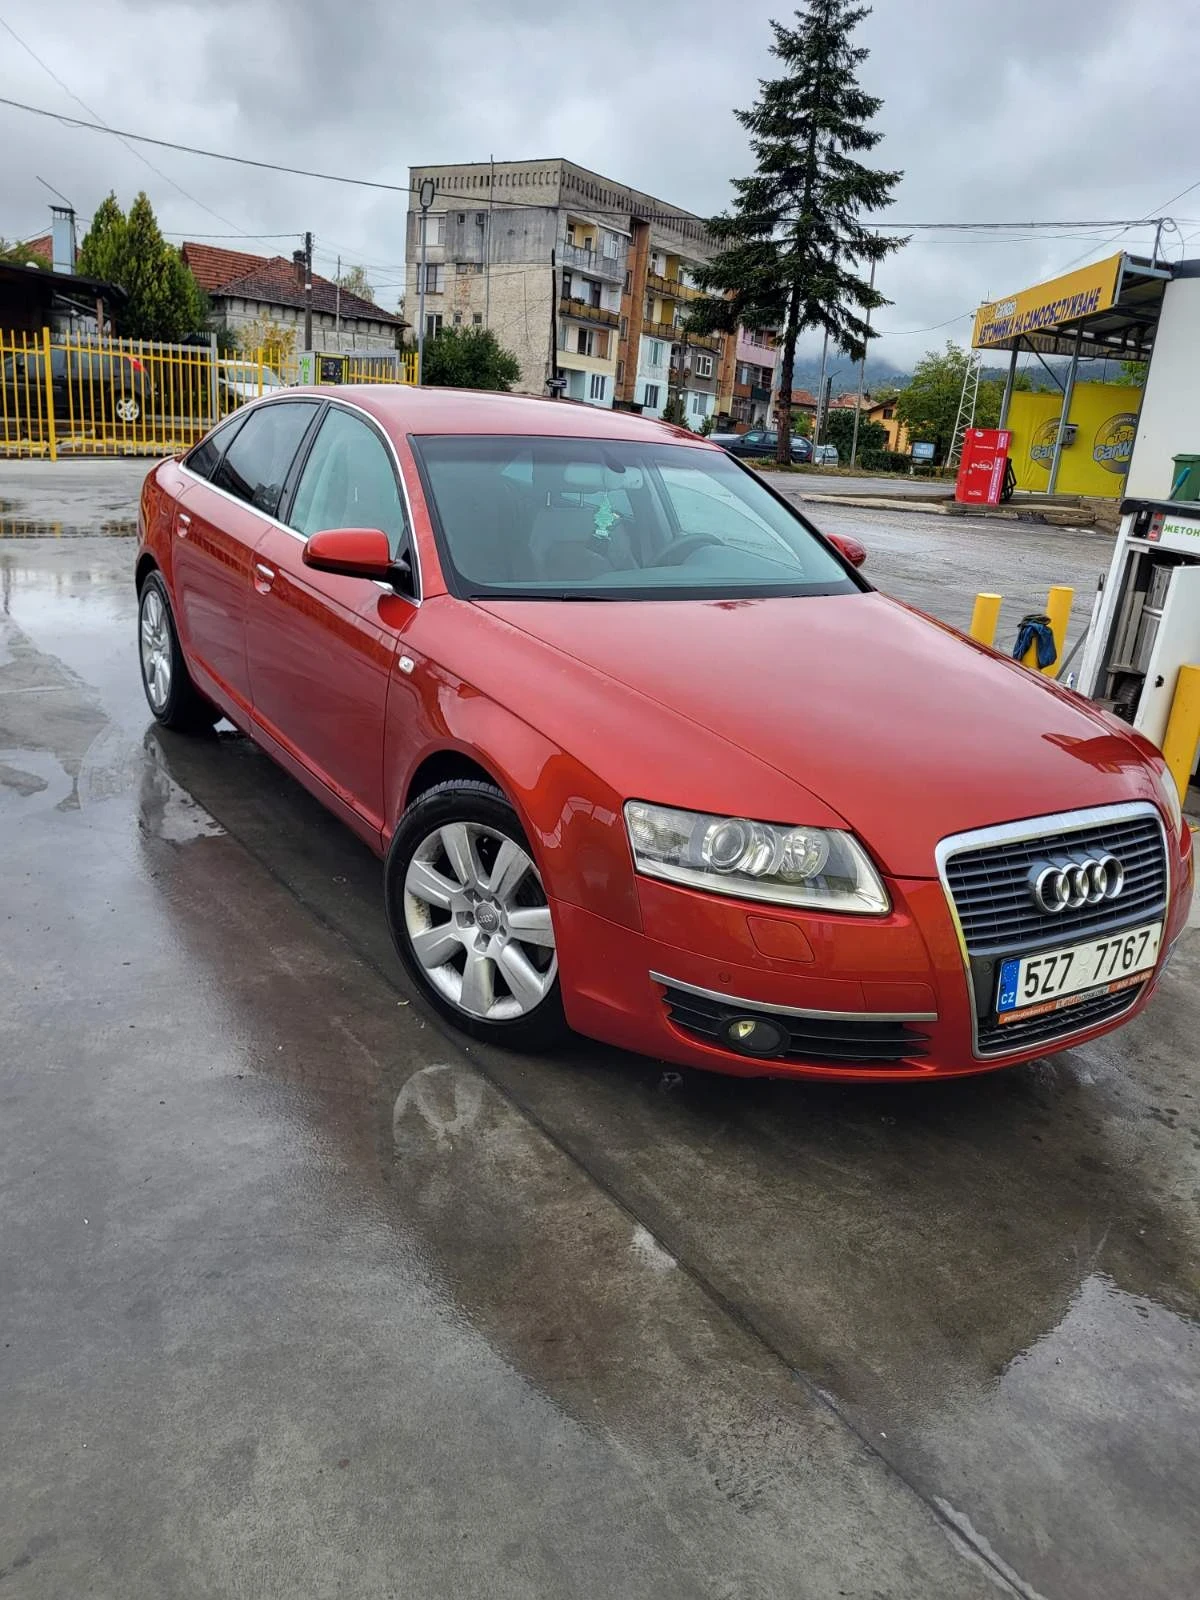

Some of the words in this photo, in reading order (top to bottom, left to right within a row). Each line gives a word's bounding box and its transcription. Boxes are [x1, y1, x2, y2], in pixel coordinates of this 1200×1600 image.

[1023, 287, 1102, 331] САМООБСЛУЖВАНЕ
[1093, 440, 1133, 461] CarW
[1024, 952, 1075, 998] 5Z7
[1093, 930, 1151, 980] 7767
[1001, 992, 1014, 1005] CZ
